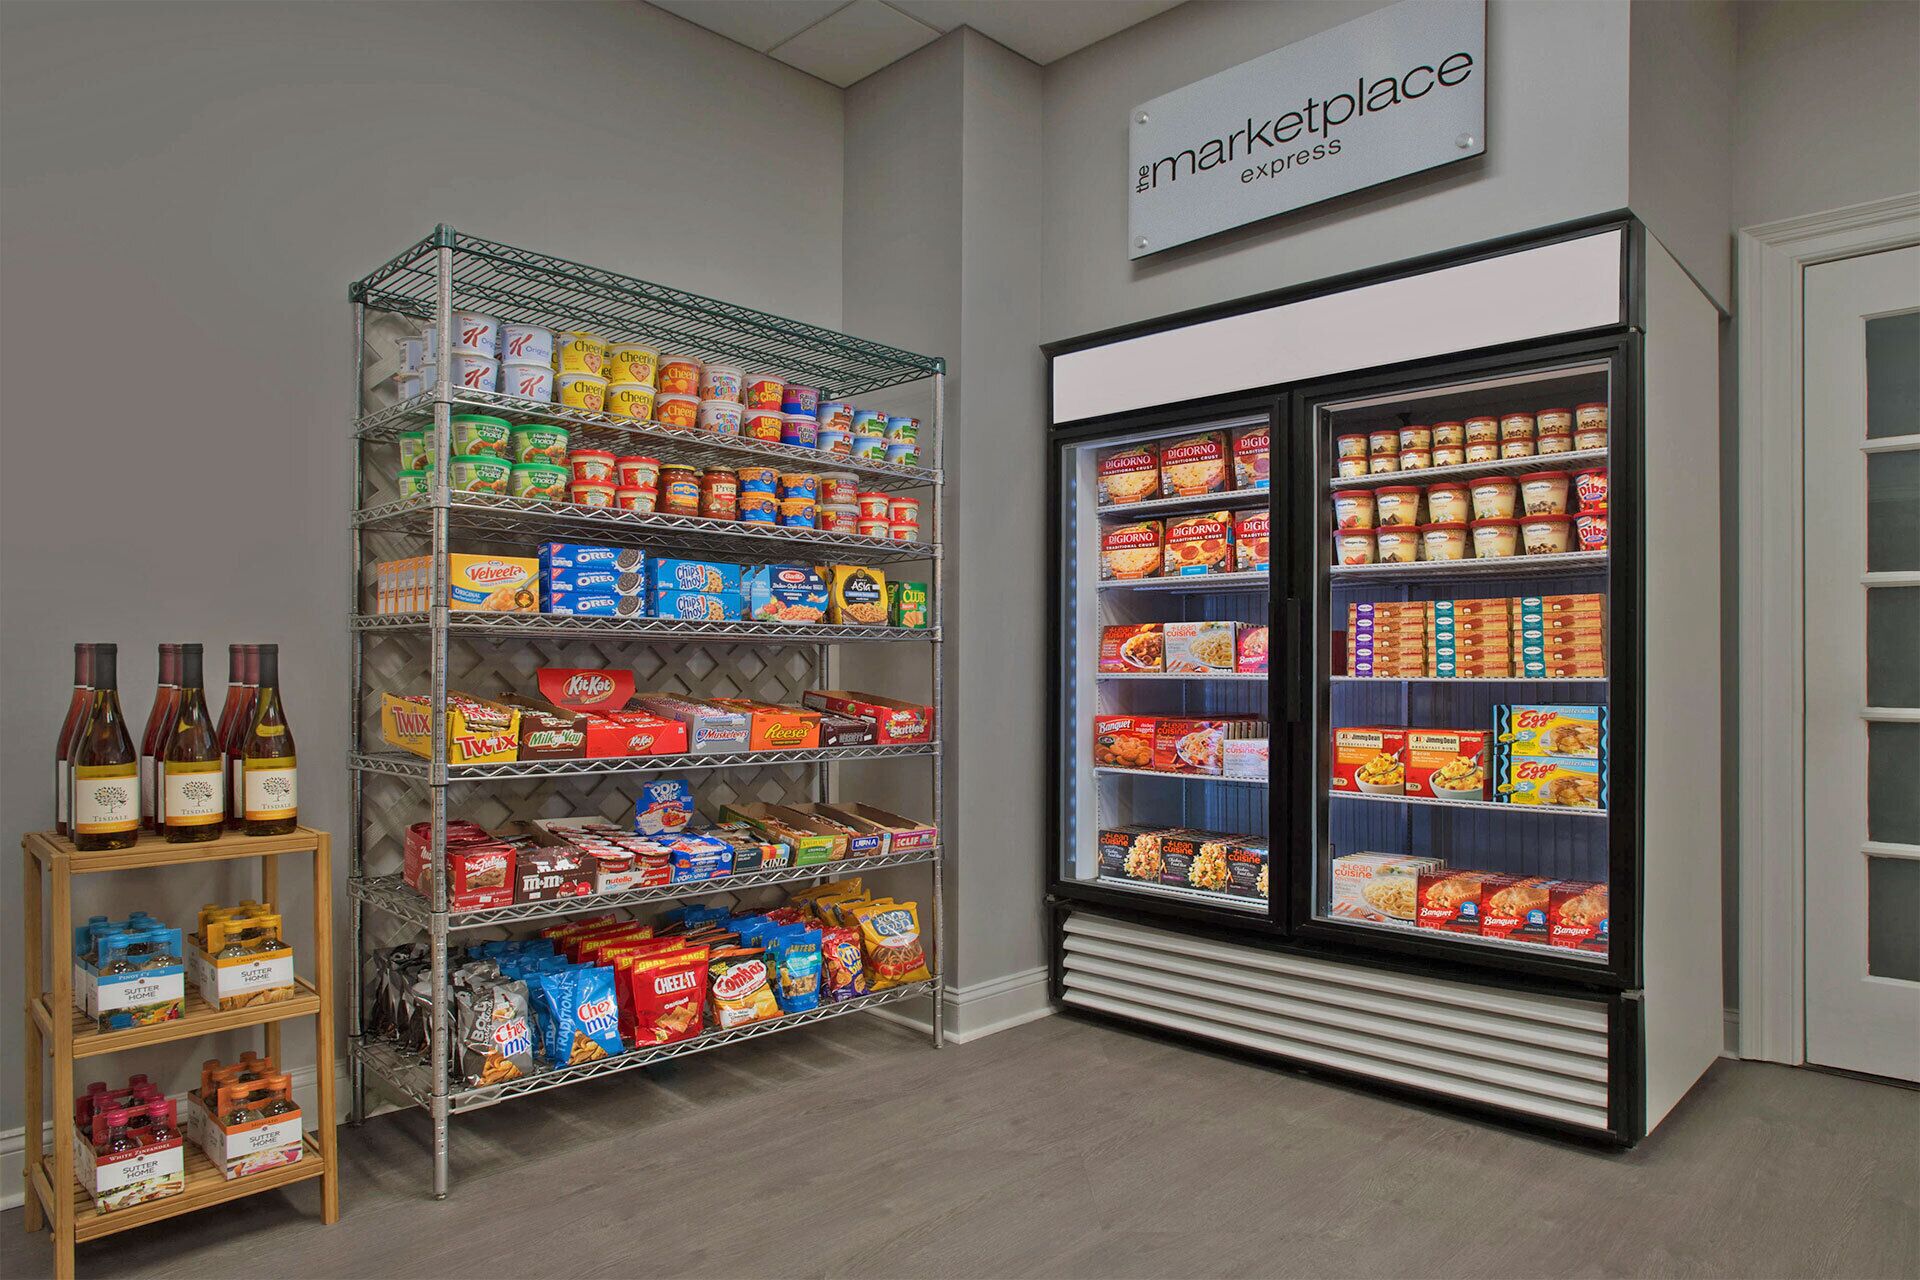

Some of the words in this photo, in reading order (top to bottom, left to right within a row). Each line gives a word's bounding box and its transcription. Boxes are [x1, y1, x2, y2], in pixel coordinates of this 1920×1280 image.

[1136, 165, 1149, 193] the
[1152, 52, 1474, 188] marketplace
[1241, 138, 1342, 184] express
[463, 325, 489, 347] K
[509, 333, 533, 357] K
[465, 367, 490, 389] K
[520, 375, 545, 397] K
[1166, 457, 1200, 466] TRADITIONAL
[1200, 453, 1219, 462] CRUST
[1103, 467, 1135, 475] TRADITIONAL
[1578, 484, 1608, 496] Dibs
[1580, 525, 1608, 538] Dibs
[1169, 535, 1203, 544] TRADITIONAL
[1106, 543, 1137, 551] TRADITIONAL
[1138, 541, 1155, 549] CRUST
[576, 552, 615, 563] OREO
[471, 565, 522, 581] Velveeta
[676, 564, 700, 581] Chips
[576, 575, 615, 587] OREO
[903, 590, 925, 603] CLUB
[577, 600, 615, 611] OREO
[677, 595, 701, 611] Chips
[1517, 710, 1558, 729] Eggo
[890, 723, 924, 738] Skittles
[1099, 720, 1131, 735] Banquet
[561, 730, 583, 746] Way
[1516, 761, 1558, 780] Eggo
[93, 815, 128, 823] TISDALE
[900, 837, 920, 846] CLIF
[1162, 846, 1194, 856] cuisine
[761, 857, 788, 869] KIND
[1228, 854, 1261, 864] cuisine
[1334, 869, 1373, 879] cuisine
[605, 876, 633, 885] nutella
[1420, 907, 1453, 918] Banquet
[1484, 915, 1520, 926] Banquet
[1552, 925, 1591, 935] Banquet
[241, 967, 272, 978] SUTTER
[244, 974, 269, 982] HOME
[716, 961, 763, 992] Combos
[124, 985, 160, 995] SUTTER
[128, 991, 156, 1000] HOME
[587, 1013, 618, 1034] mix
[495, 1018, 527, 1043] Chex
[504, 1032, 531, 1057] mix
[249, 1131, 280, 1143] SUTTER
[252, 1138, 277, 1148] HOME
[109, 1153, 133, 1161] WHITE
[135, 1143, 171, 1156] ZINFANDEL
[122, 1160, 159, 1175] SUTTER
[127, 1168, 155, 1179] HOME
